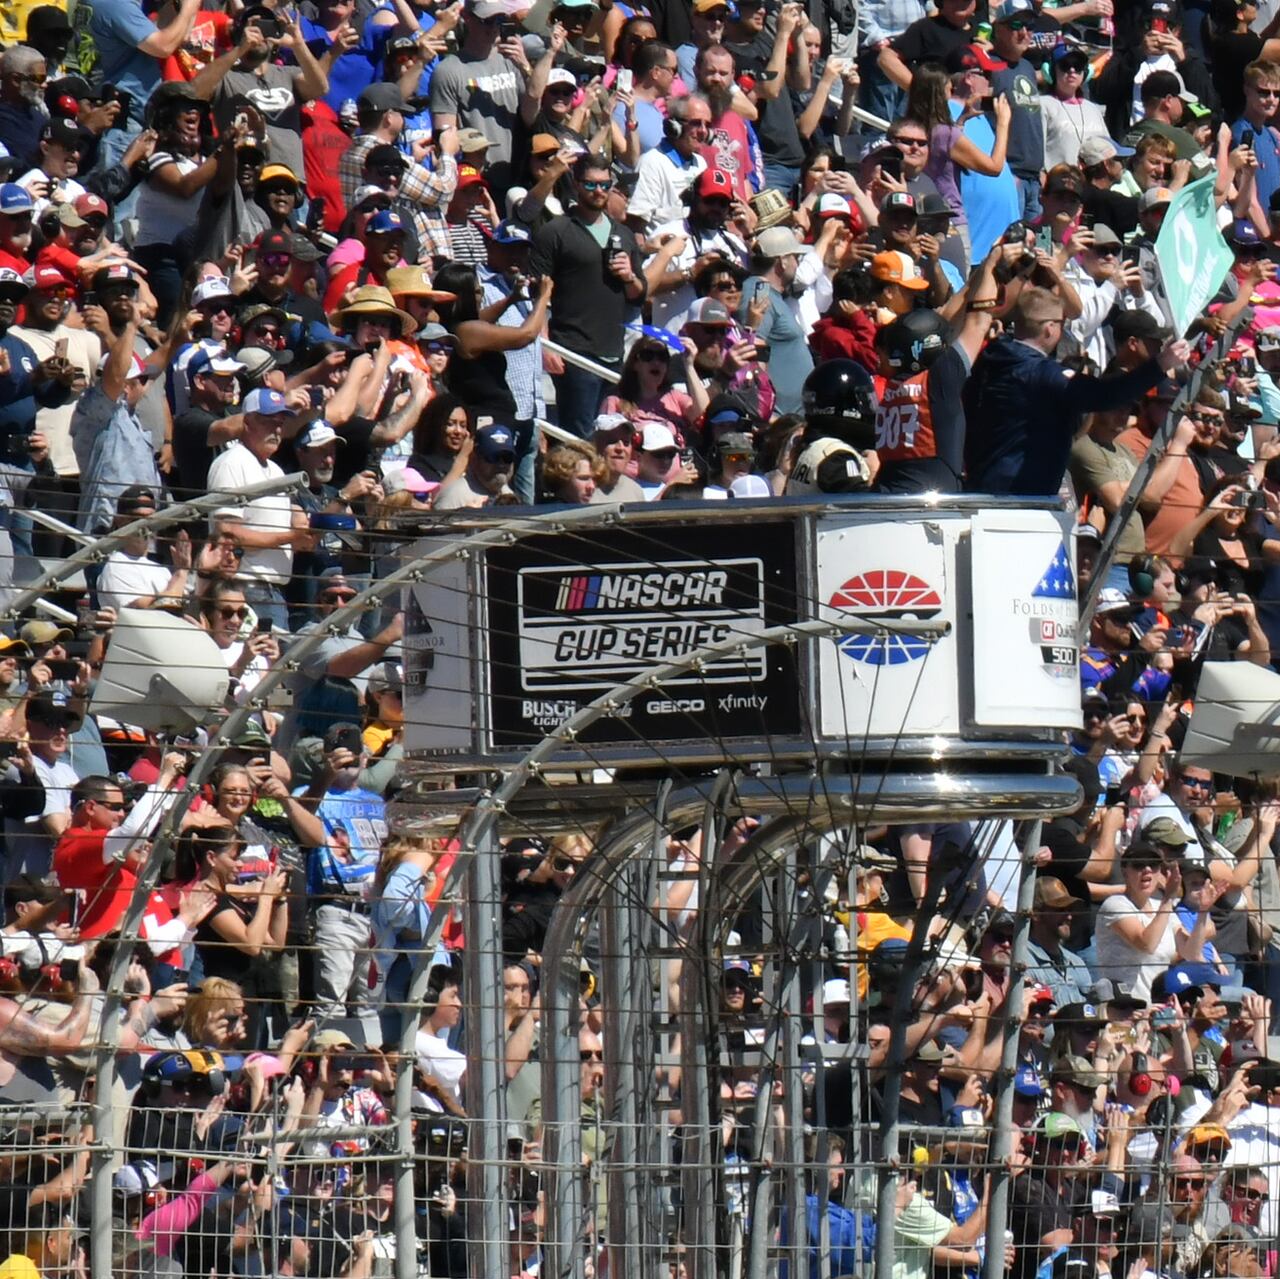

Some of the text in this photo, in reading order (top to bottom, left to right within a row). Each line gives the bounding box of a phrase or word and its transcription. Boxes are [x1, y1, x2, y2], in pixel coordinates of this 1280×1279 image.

[597, 571, 728, 609] NASCAR
[554, 626, 619, 663] CUP
[1052, 648, 1074, 664] 500
[522, 700, 577, 719] BUSCH
[646, 700, 705, 714] GEICO
[718, 694, 768, 713] xfinity
